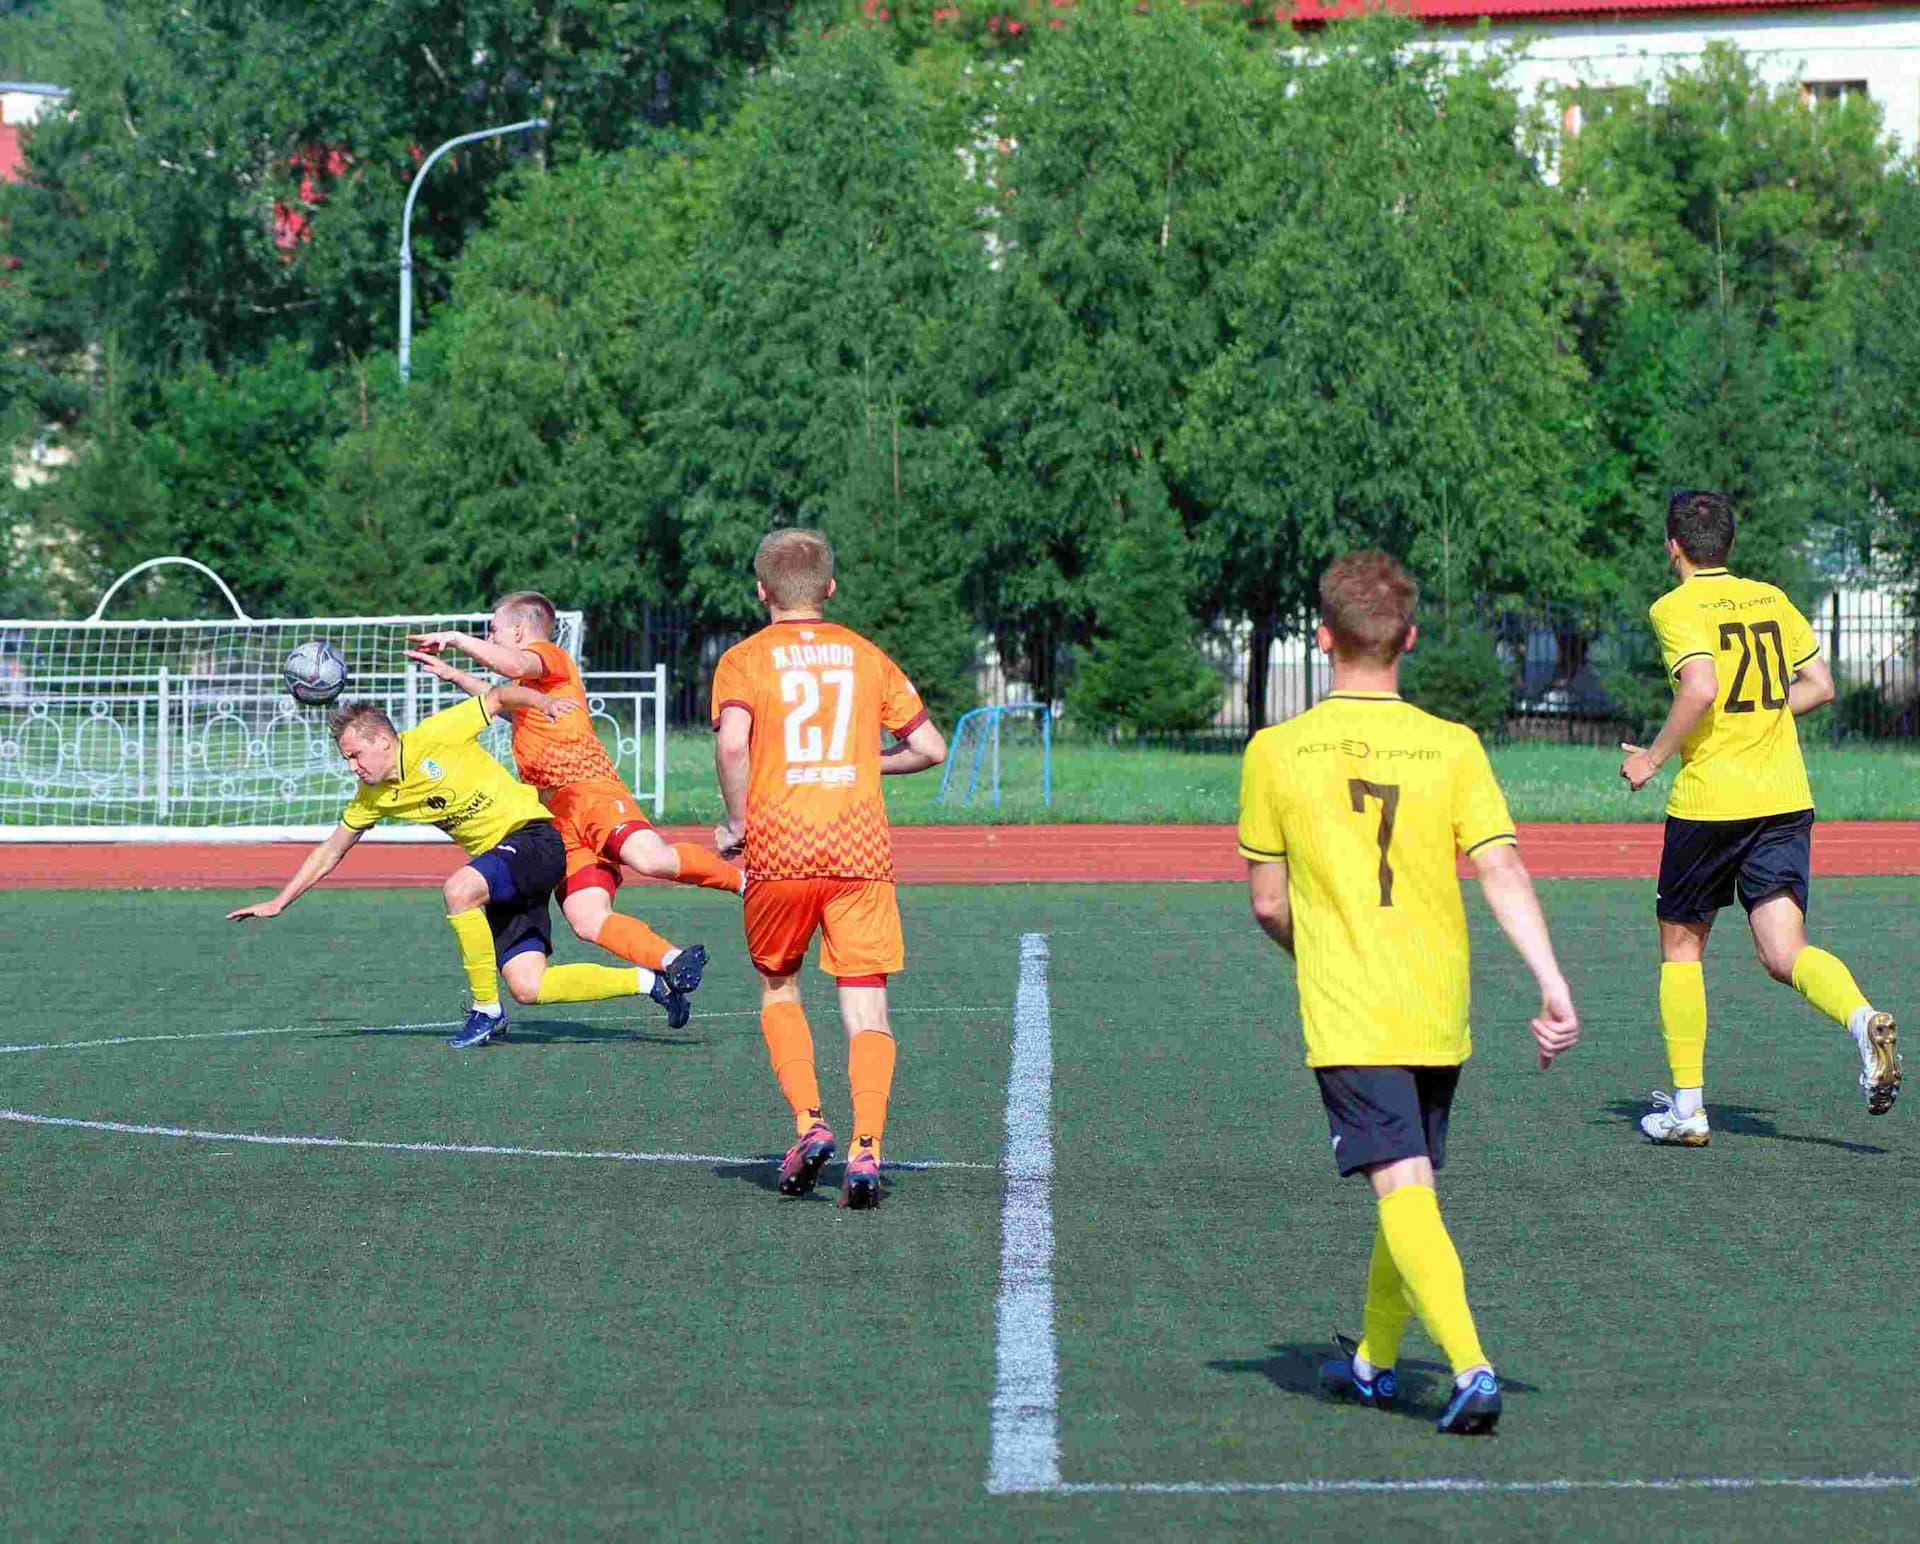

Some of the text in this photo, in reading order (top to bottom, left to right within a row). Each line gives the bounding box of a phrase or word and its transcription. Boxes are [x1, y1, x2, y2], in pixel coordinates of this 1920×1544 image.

[1718, 620, 1790, 713] 20
[781, 670, 854, 762] 27
[1348, 778, 1400, 907] 7
